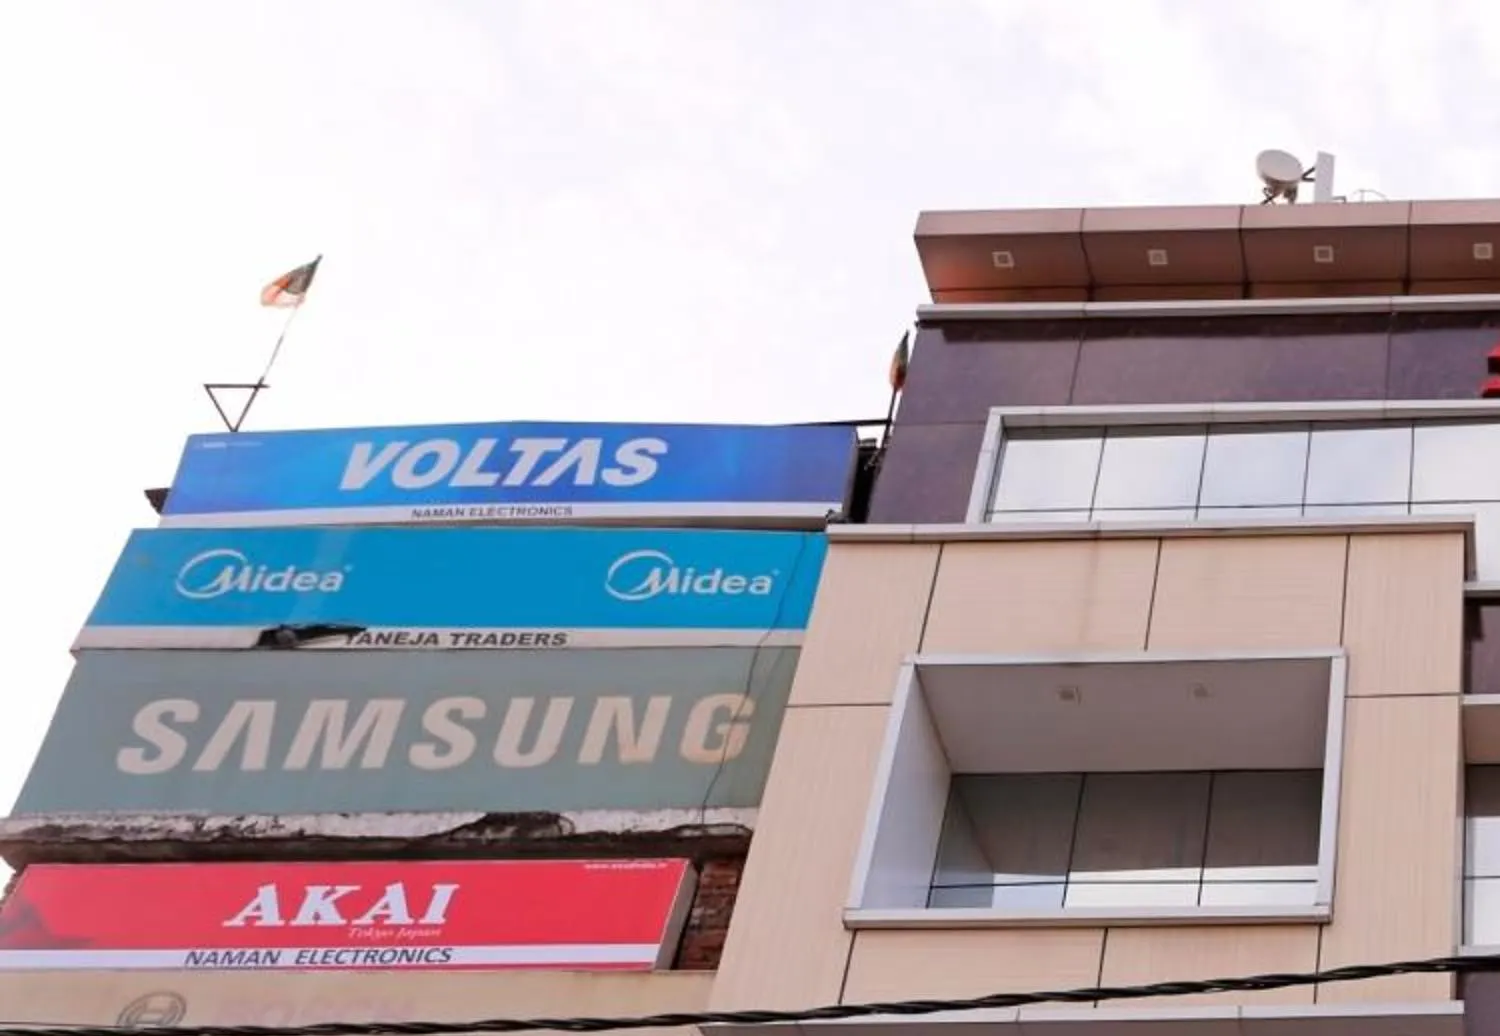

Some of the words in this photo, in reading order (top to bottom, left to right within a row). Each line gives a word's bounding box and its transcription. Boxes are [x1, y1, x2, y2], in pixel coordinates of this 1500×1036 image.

[339, 437, 668, 490] VOLTAS
[411, 508, 465, 518] NAMAN
[469, 505, 573, 517] ELECTRONICS
[175, 548, 346, 599] Midea
[605, 549, 774, 600] Midea
[345, 631, 439, 646] TANEJA
[450, 631, 568, 646] TRADERS
[116, 693, 756, 775] SAMSUNG
[222, 882, 460, 927] AKAI
[184, 950, 280, 965] NAMAN
[294, 947, 452, 965] ELECTRONICS
